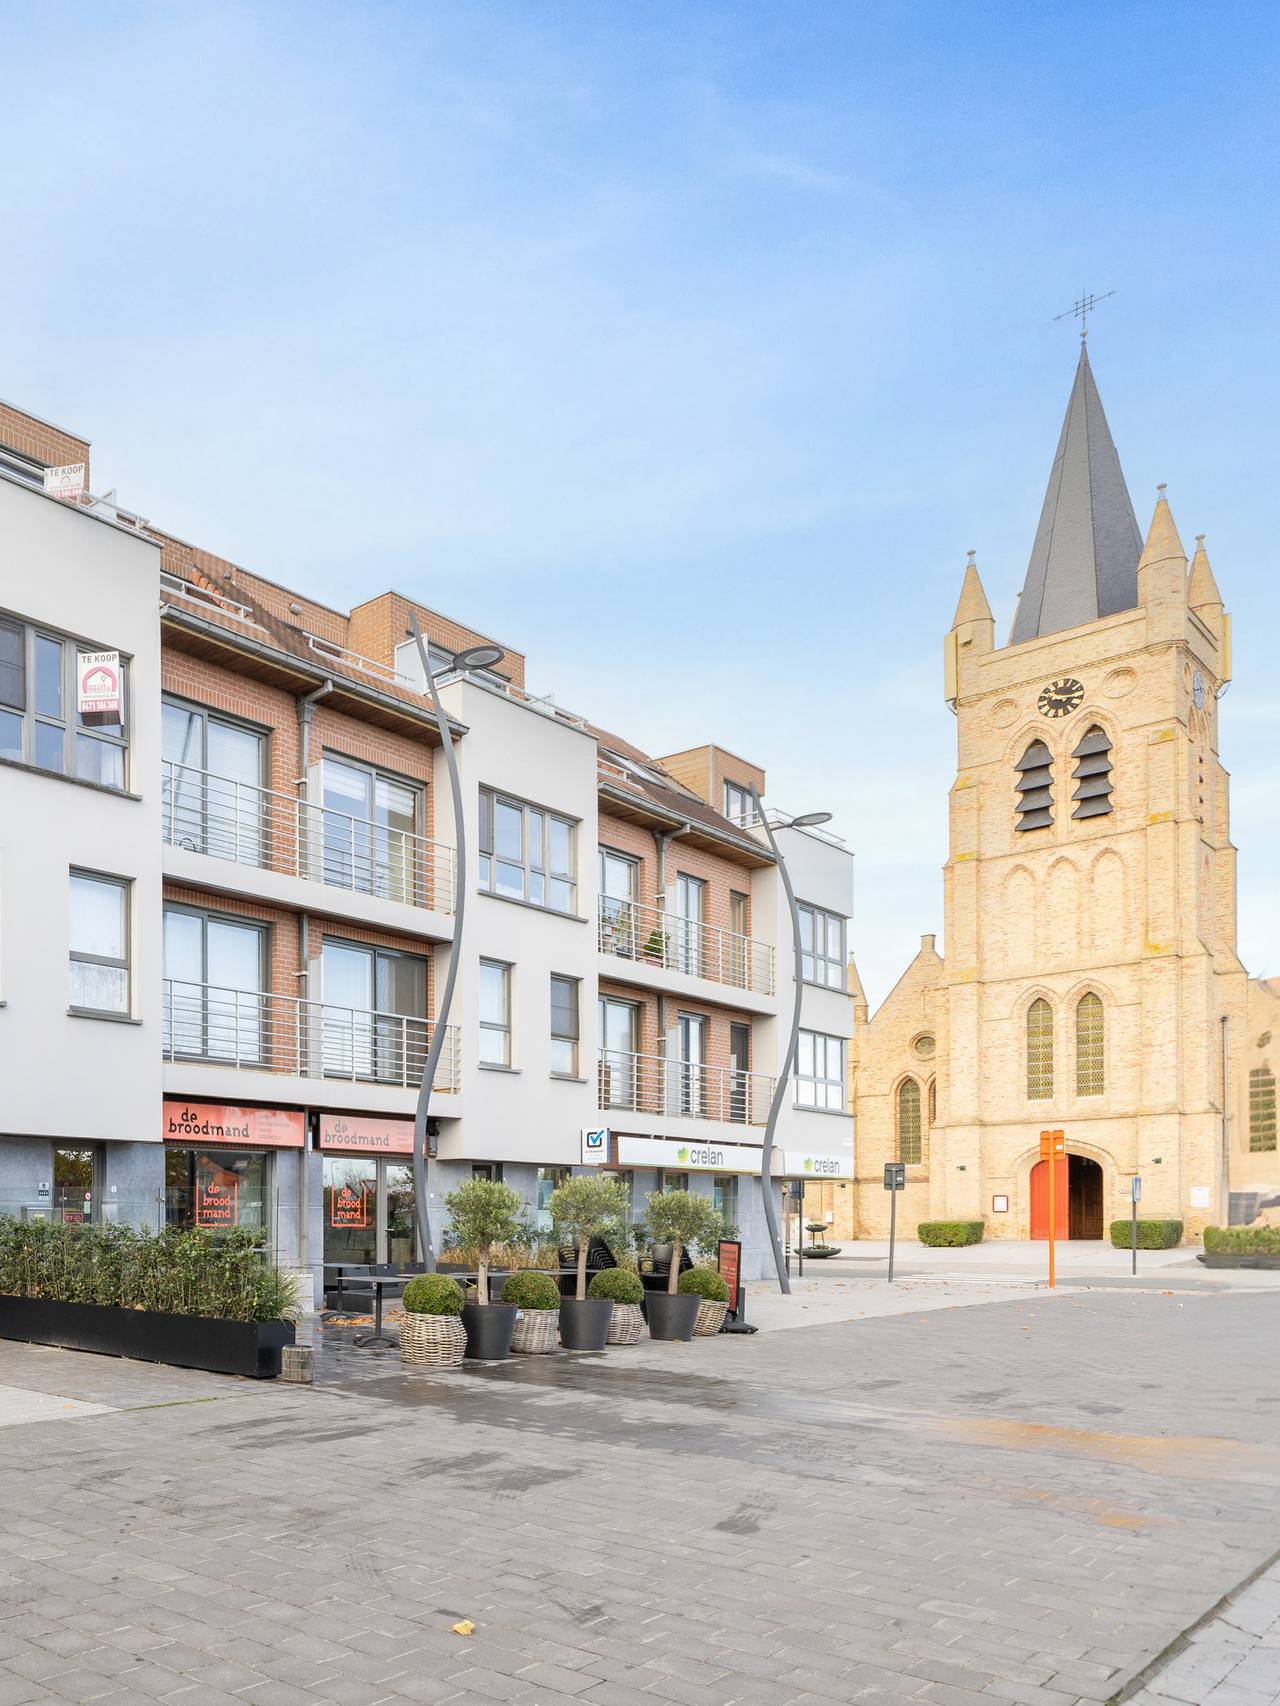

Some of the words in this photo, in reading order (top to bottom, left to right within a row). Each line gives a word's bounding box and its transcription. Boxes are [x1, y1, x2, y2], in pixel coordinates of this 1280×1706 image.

[48, 469, 60, 477] TE
[61, 464, 84, 476] KOOP
[81, 655, 93, 664] TE
[94, 654, 117, 664] KOOP
[181, 1107, 198, 1122] de
[168, 1117, 250, 1138] broodmand
[334, 1119, 349, 1133] de
[324, 1129, 391, 1147] broodmand
[690, 1147, 724, 1166] crelan
[814, 1157, 841, 1174] crelan
[207, 1181, 220, 1194] de
[341, 1186, 353, 1197] de
[202, 1193, 231, 1206] brood
[337, 1197, 362, 1208] brood
[202, 1206, 231, 1218] mand
[337, 1208, 362, 1219] mand
